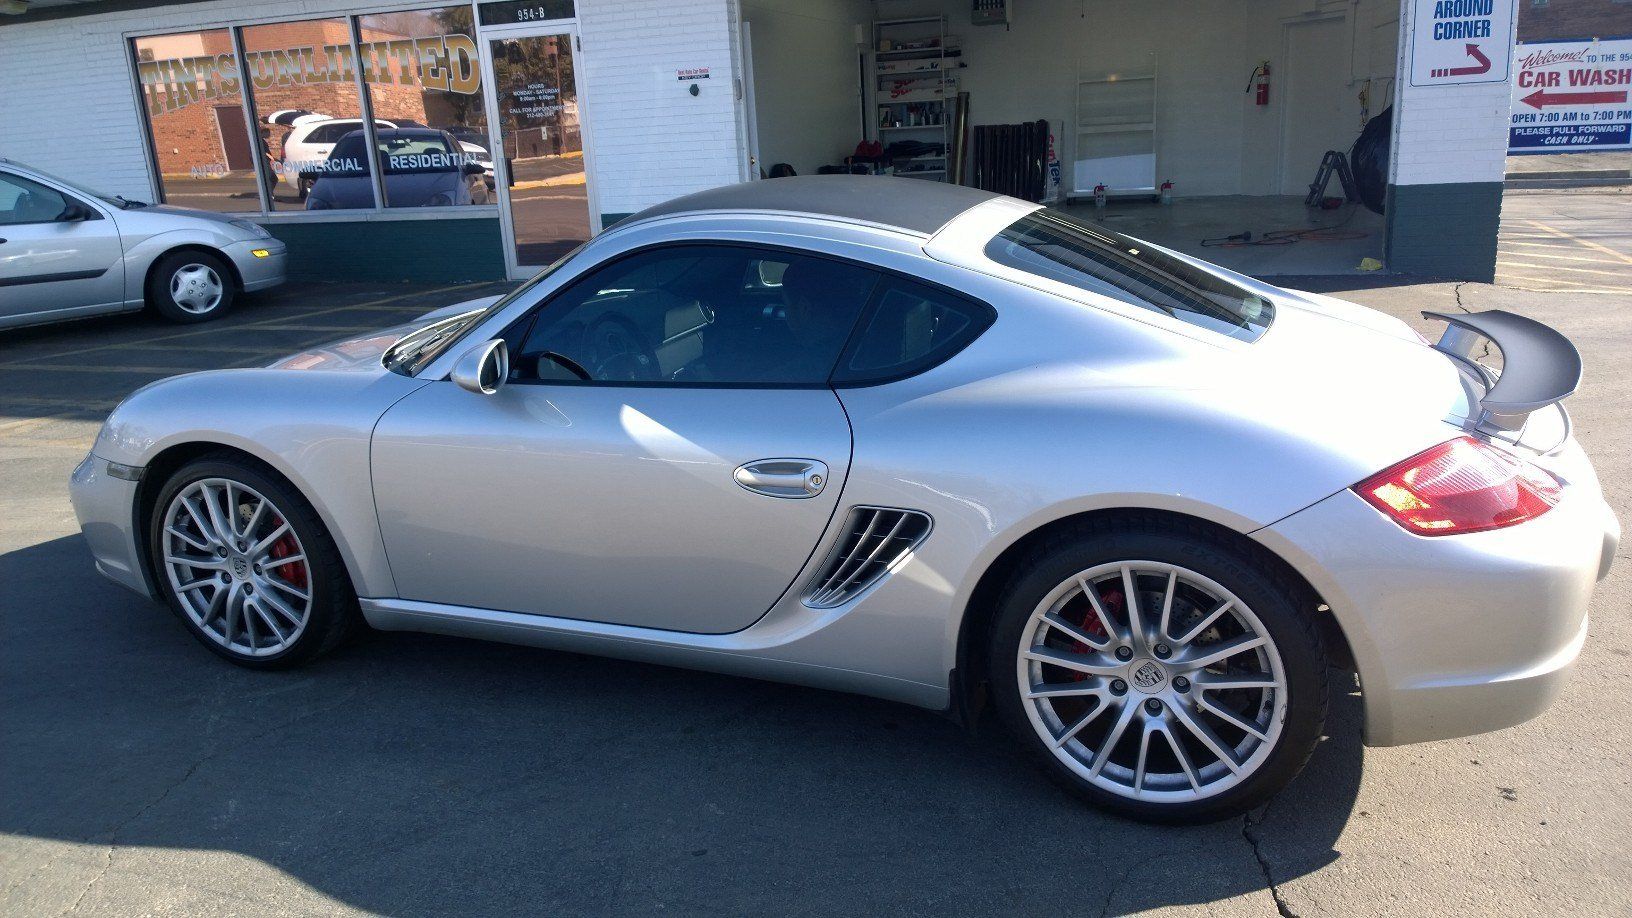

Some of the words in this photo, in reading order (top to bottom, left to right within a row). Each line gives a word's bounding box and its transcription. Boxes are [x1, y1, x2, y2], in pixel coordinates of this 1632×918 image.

[517, 6, 545, 21] 954-B
[1434, 0, 1494, 19] AROUND
[1433, 19, 1491, 40] CORNER
[1518, 47, 1590, 69] Welcome!
[1587, 54, 1598, 63] TO
[1601, 53, 1617, 62] THE
[137, 53, 241, 118] TINTS
[245, 33, 482, 95] UNLIMITED
[1518, 70, 1561, 88] CAR
[1568, 68, 1632, 87] WASH
[1512, 113, 1536, 123] OPEN
[1540, 112, 1560, 122] 7:00
[1562, 112, 1578, 122] AM
[1580, 112, 1590, 121] to
[1593, 111, 1614, 121] 7:00
[1616, 110, 1632, 120] PM
[1515, 127, 1551, 136] PLEASE
[1553, 126, 1574, 135] PULL
[1578, 125, 1627, 134] FORWARD
[191, 163, 226, 177] AUTO
[271, 157, 363, 174] COMMERCIAL
[389, 152, 479, 170] RESIDENTIAL
